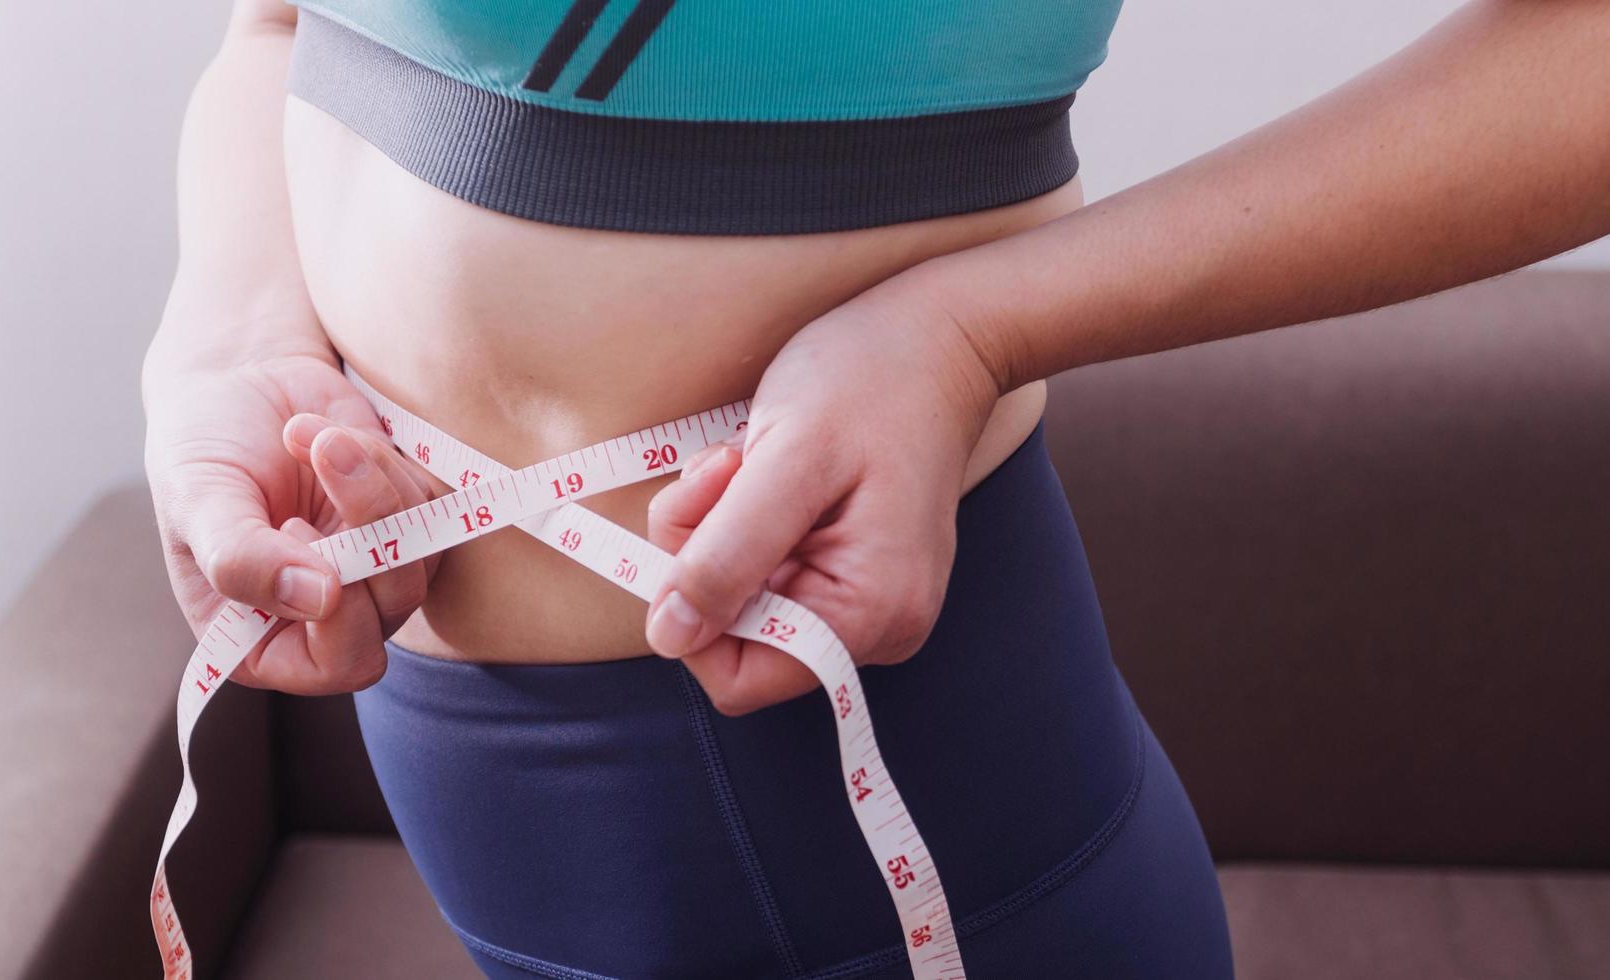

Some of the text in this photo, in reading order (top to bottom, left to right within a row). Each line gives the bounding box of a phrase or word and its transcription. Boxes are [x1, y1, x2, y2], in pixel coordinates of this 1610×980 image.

[367, 443, 678, 568] 17 18 19 20
[415, 442, 430, 465] 46
[459, 469, 481, 488] 47
[559, 527, 638, 584] 49 50
[195, 608, 274, 696] 14 1
[759, 616, 933, 948] 52 53 54 55 56
